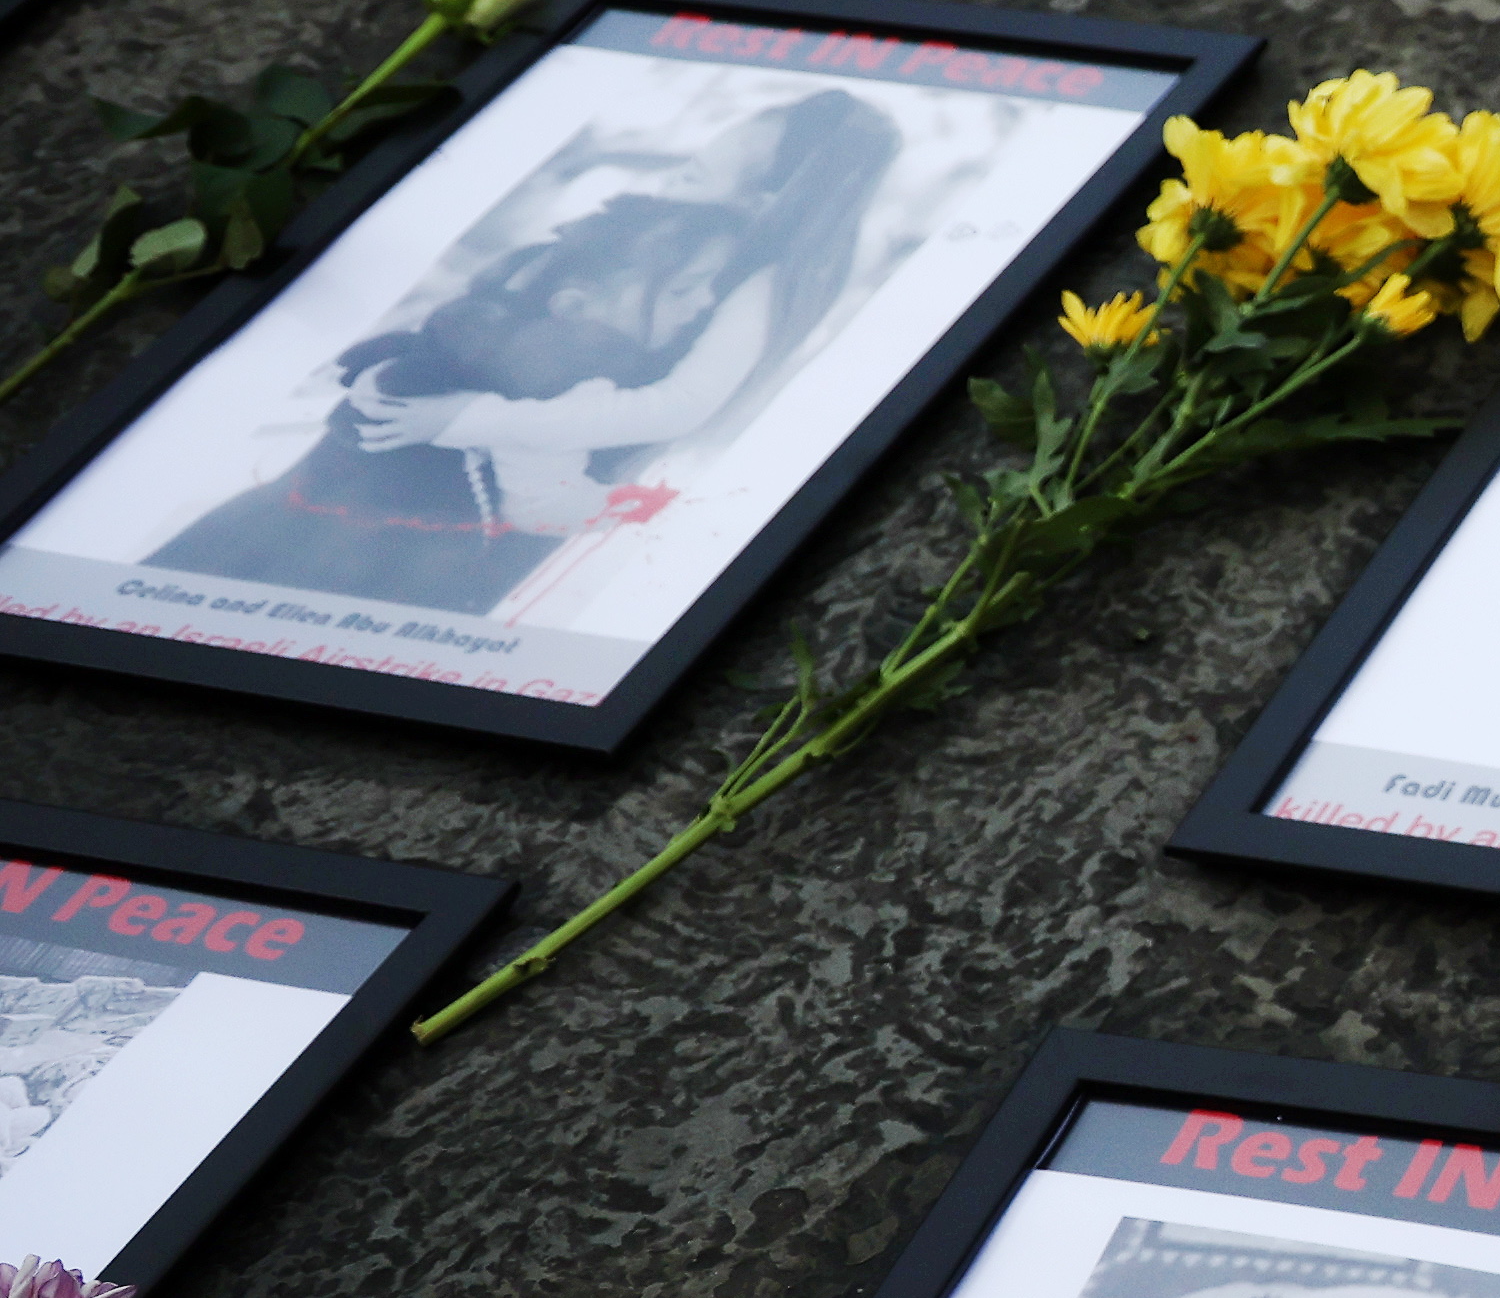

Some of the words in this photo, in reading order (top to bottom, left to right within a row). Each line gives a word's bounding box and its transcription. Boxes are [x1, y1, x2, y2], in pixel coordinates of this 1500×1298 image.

[650, 10, 802, 61] Rest
[808, 28, 901, 70] IN
[901, 40, 1104, 97] Peace
[515, 678, 600, 708] Gaz
[1384, 774, 1456, 800] Fadi
[1275, 797, 1400, 833] killed
[1405, 815, 1461, 842] by
[0, 859, 64, 912] N
[53, 874, 304, 960] Peace
[1163, 1108, 1381, 1189] Rest
